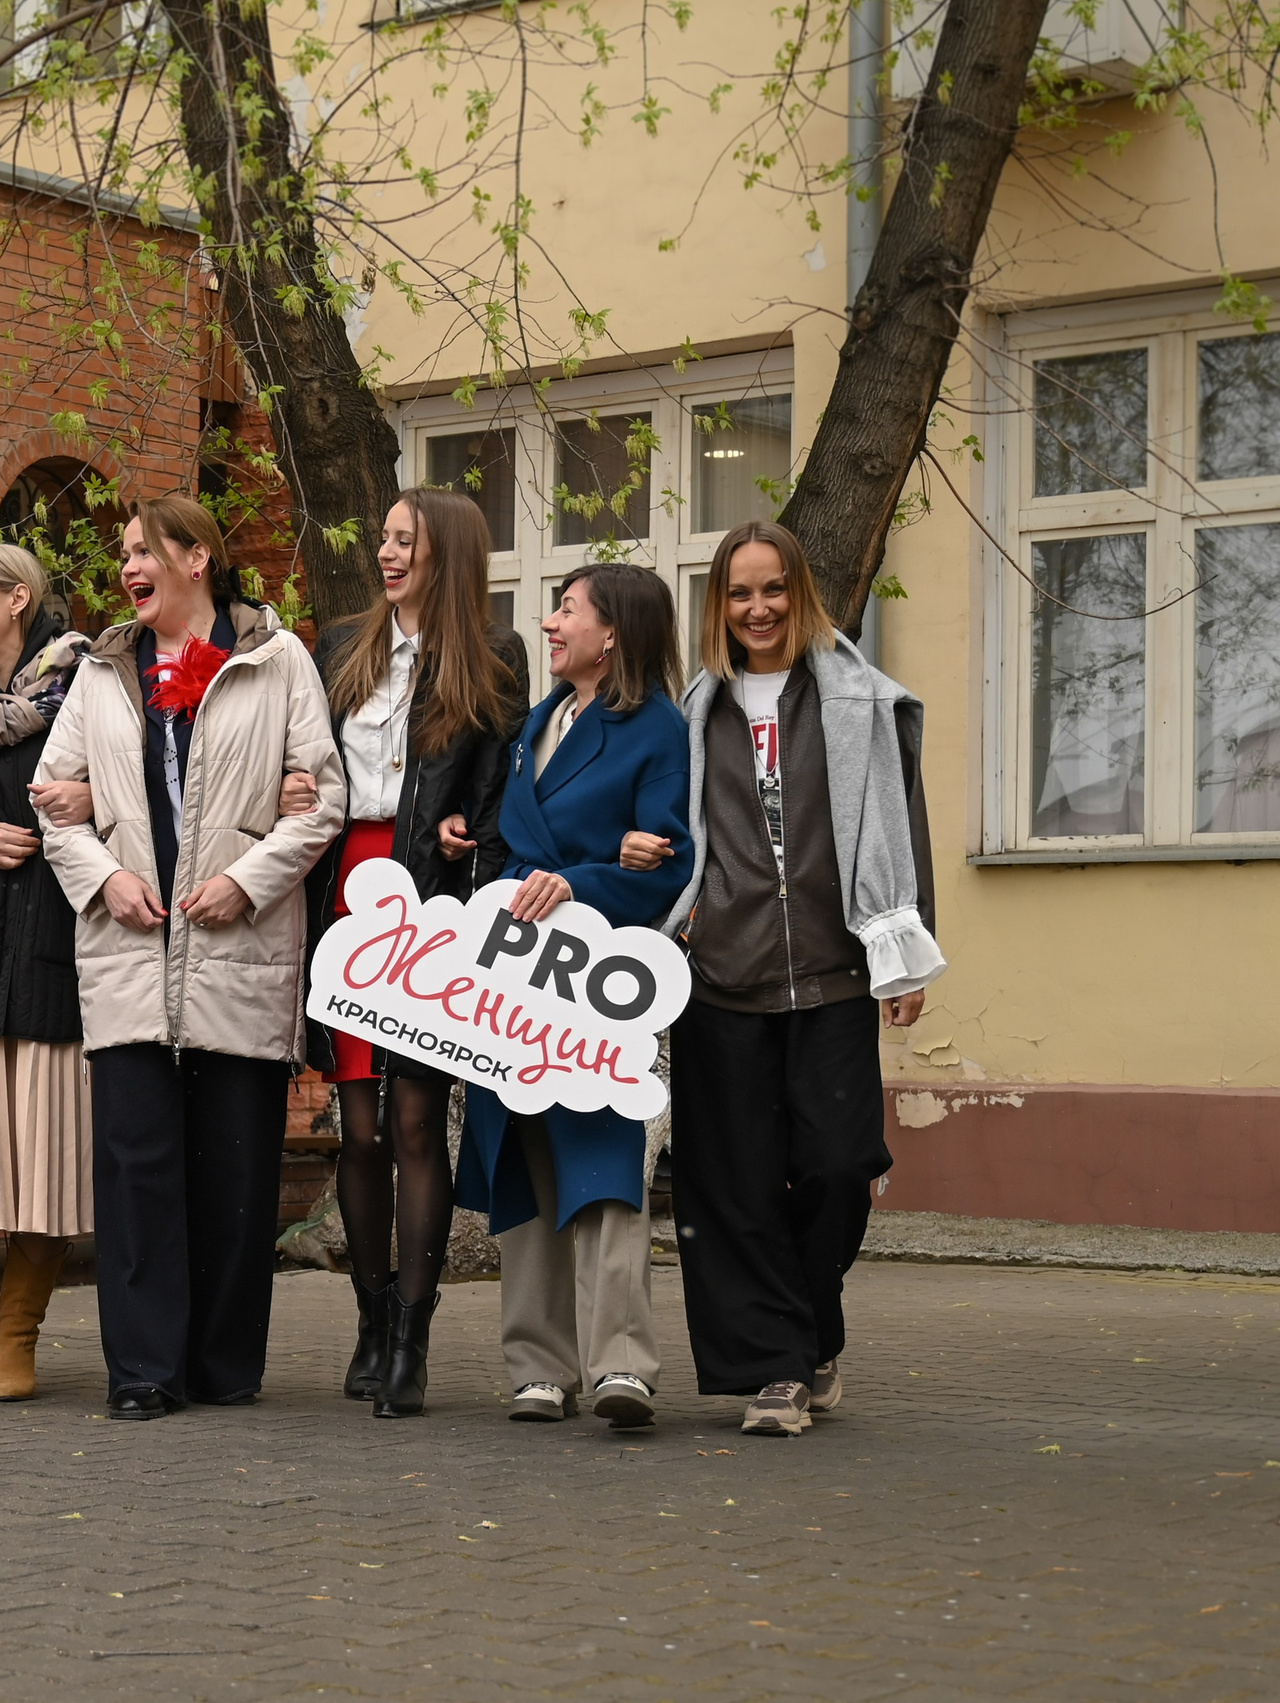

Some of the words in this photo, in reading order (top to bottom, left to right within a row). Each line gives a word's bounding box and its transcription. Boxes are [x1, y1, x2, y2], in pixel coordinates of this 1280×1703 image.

[342, 894, 640, 1085] Женщин
[475, 908, 657, 1021] PRO
[326, 994, 513, 1083] КРАСНОЯРСК
